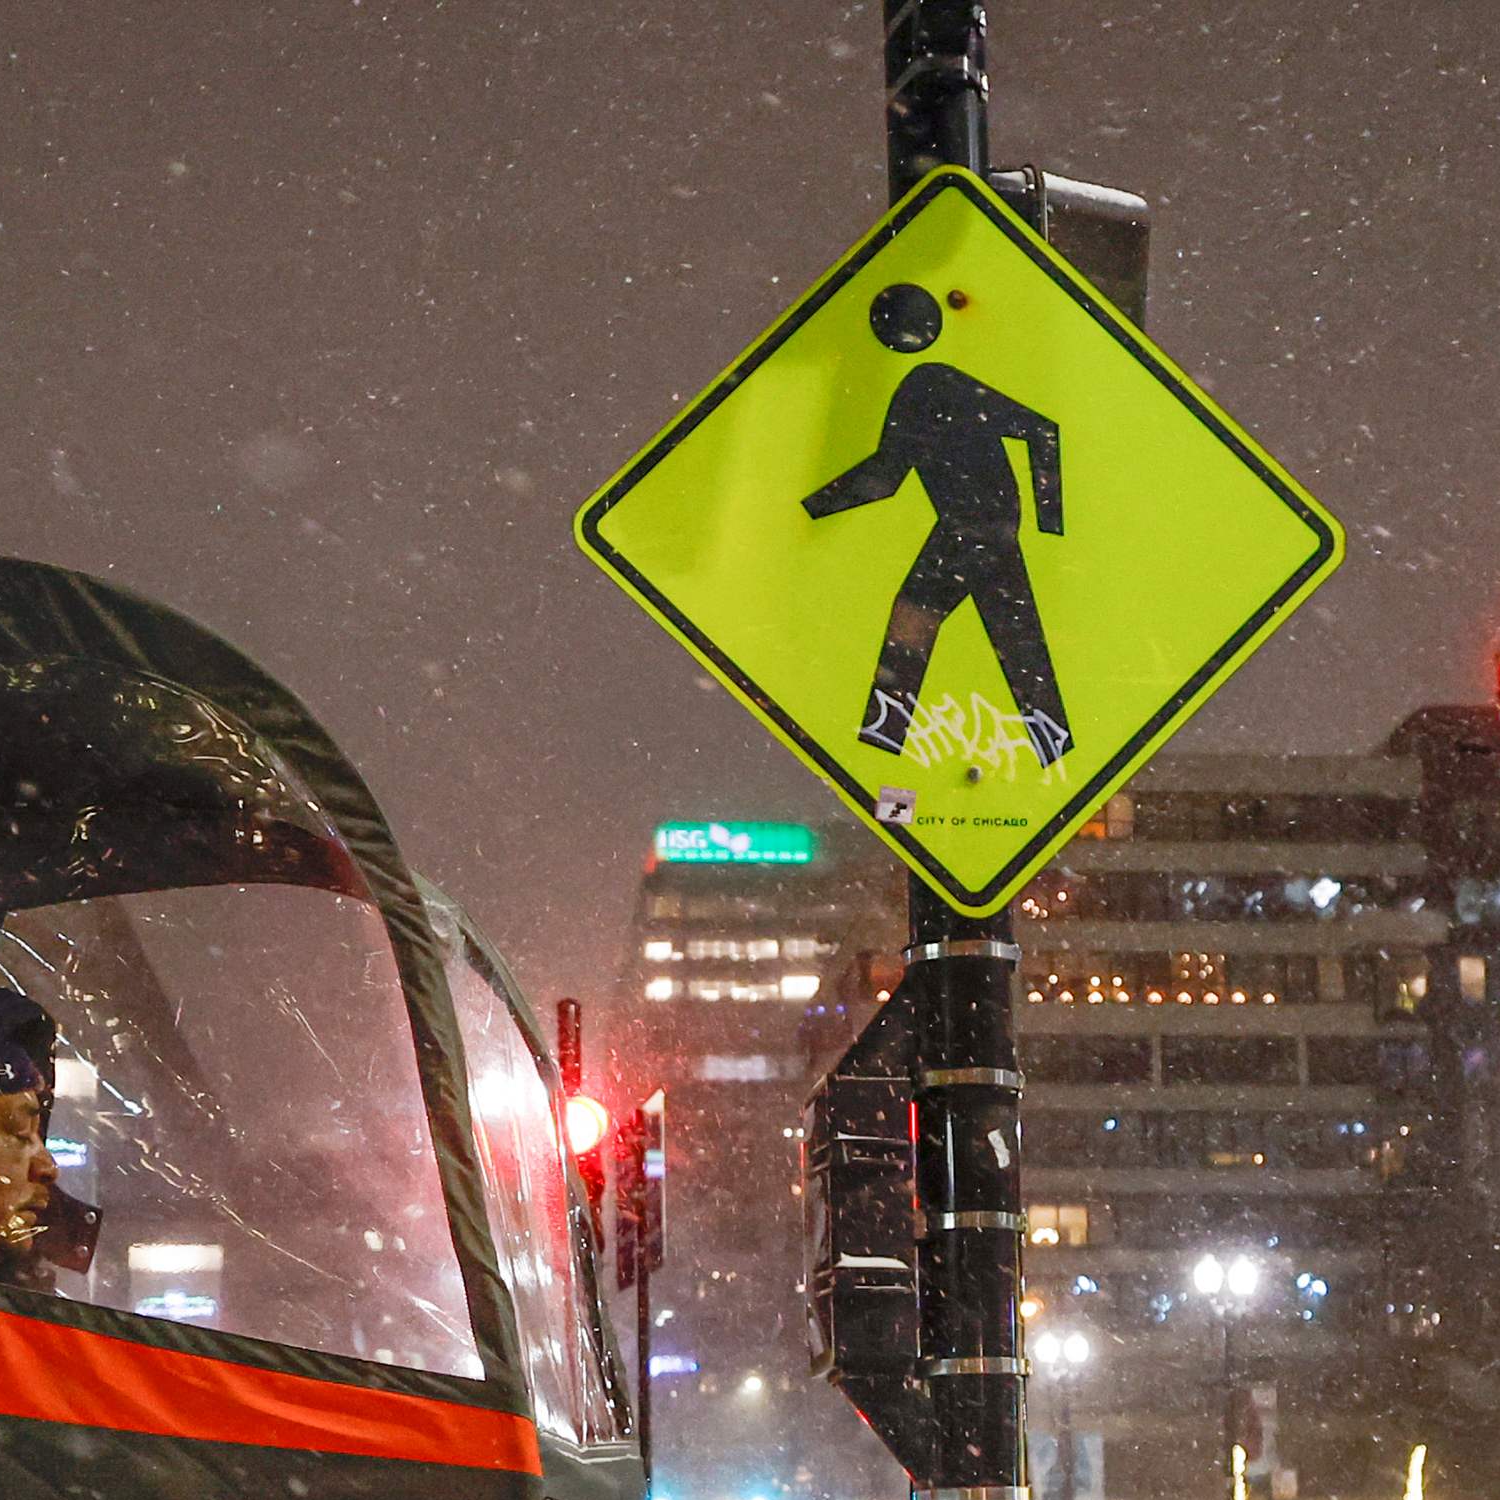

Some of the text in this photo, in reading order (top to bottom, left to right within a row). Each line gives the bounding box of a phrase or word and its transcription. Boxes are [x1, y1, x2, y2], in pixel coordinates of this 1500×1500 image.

[916, 816, 1029, 827] CITY OF CHICAGO
